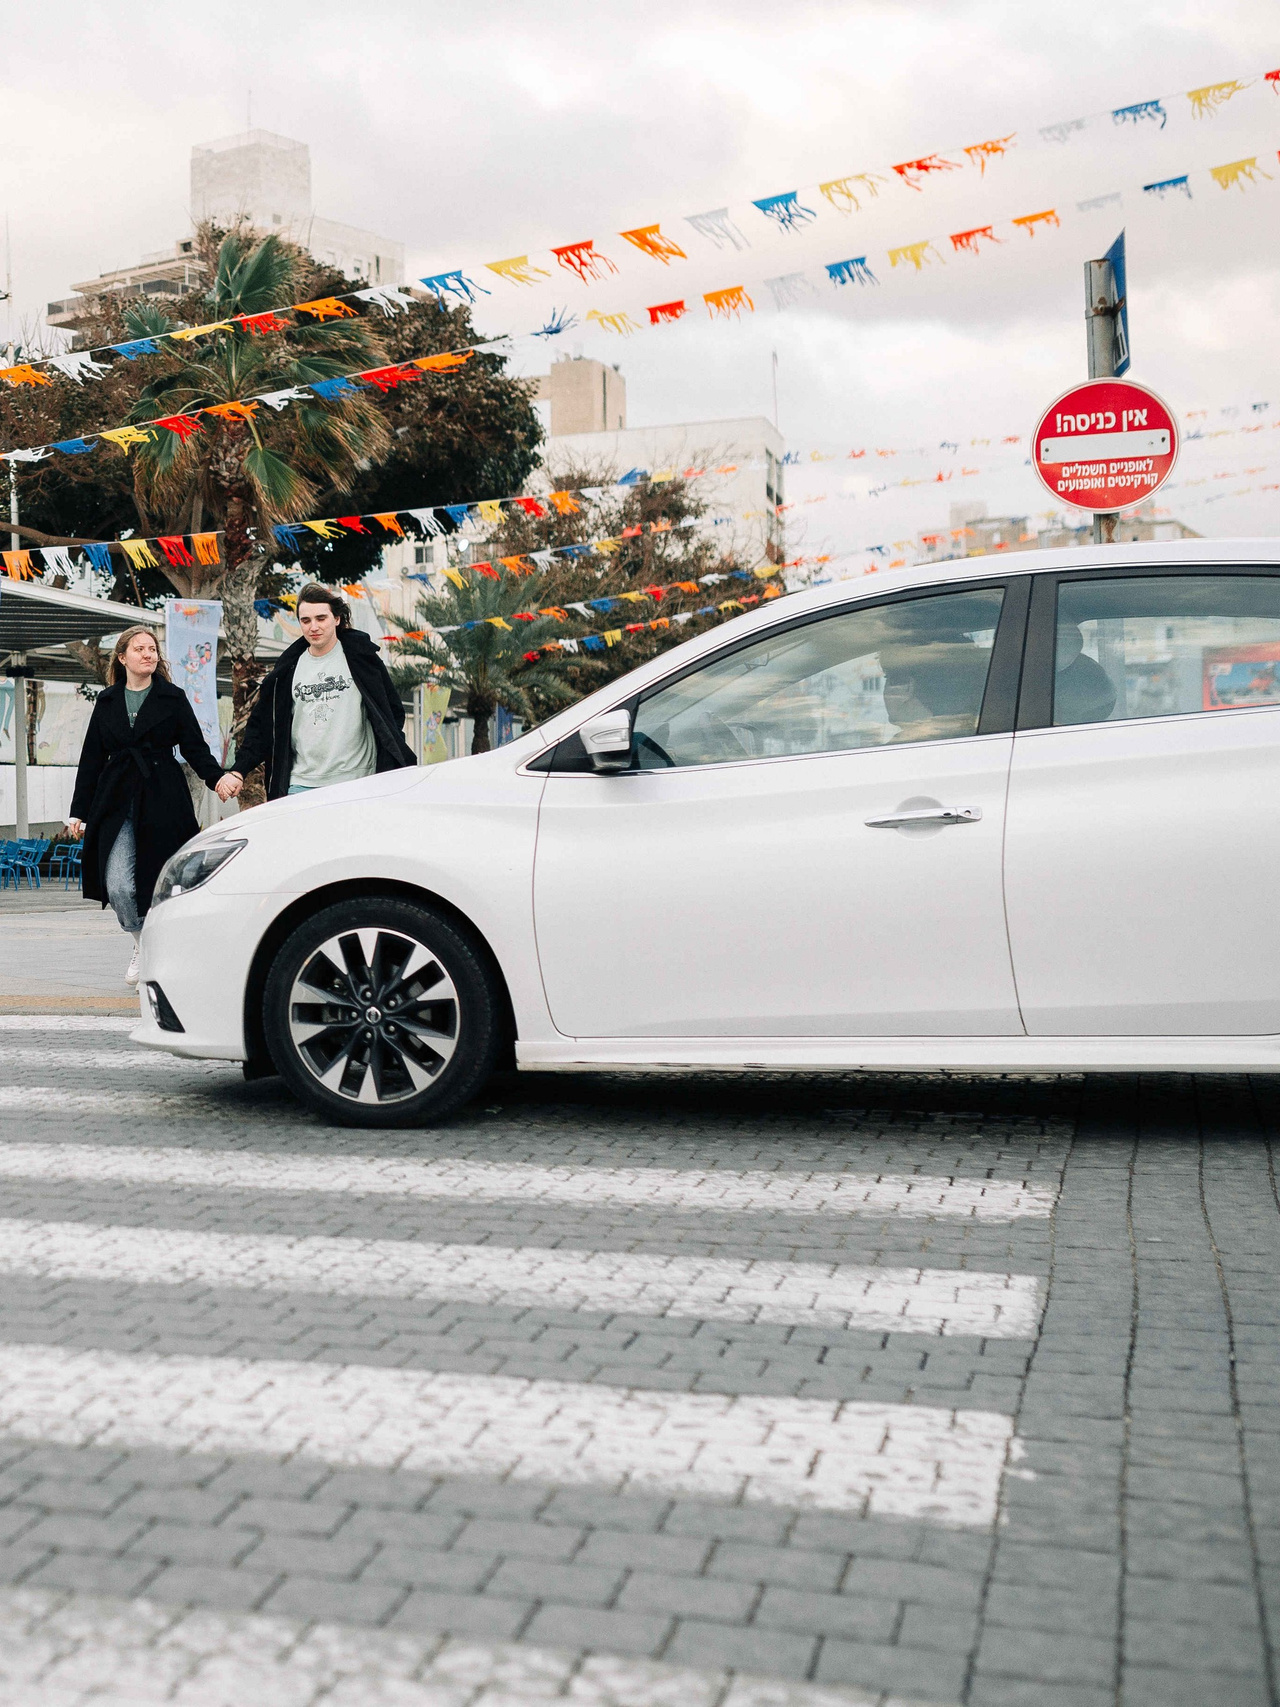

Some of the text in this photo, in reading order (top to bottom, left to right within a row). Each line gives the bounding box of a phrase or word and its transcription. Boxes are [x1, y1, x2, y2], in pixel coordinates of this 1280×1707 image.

[1055, 408, 1148, 433] אין כניסה!
[1061, 458, 1154, 478] לאופניים חשמליים
[1057, 473, 1159, 493] קורקינטים ואופנועים
